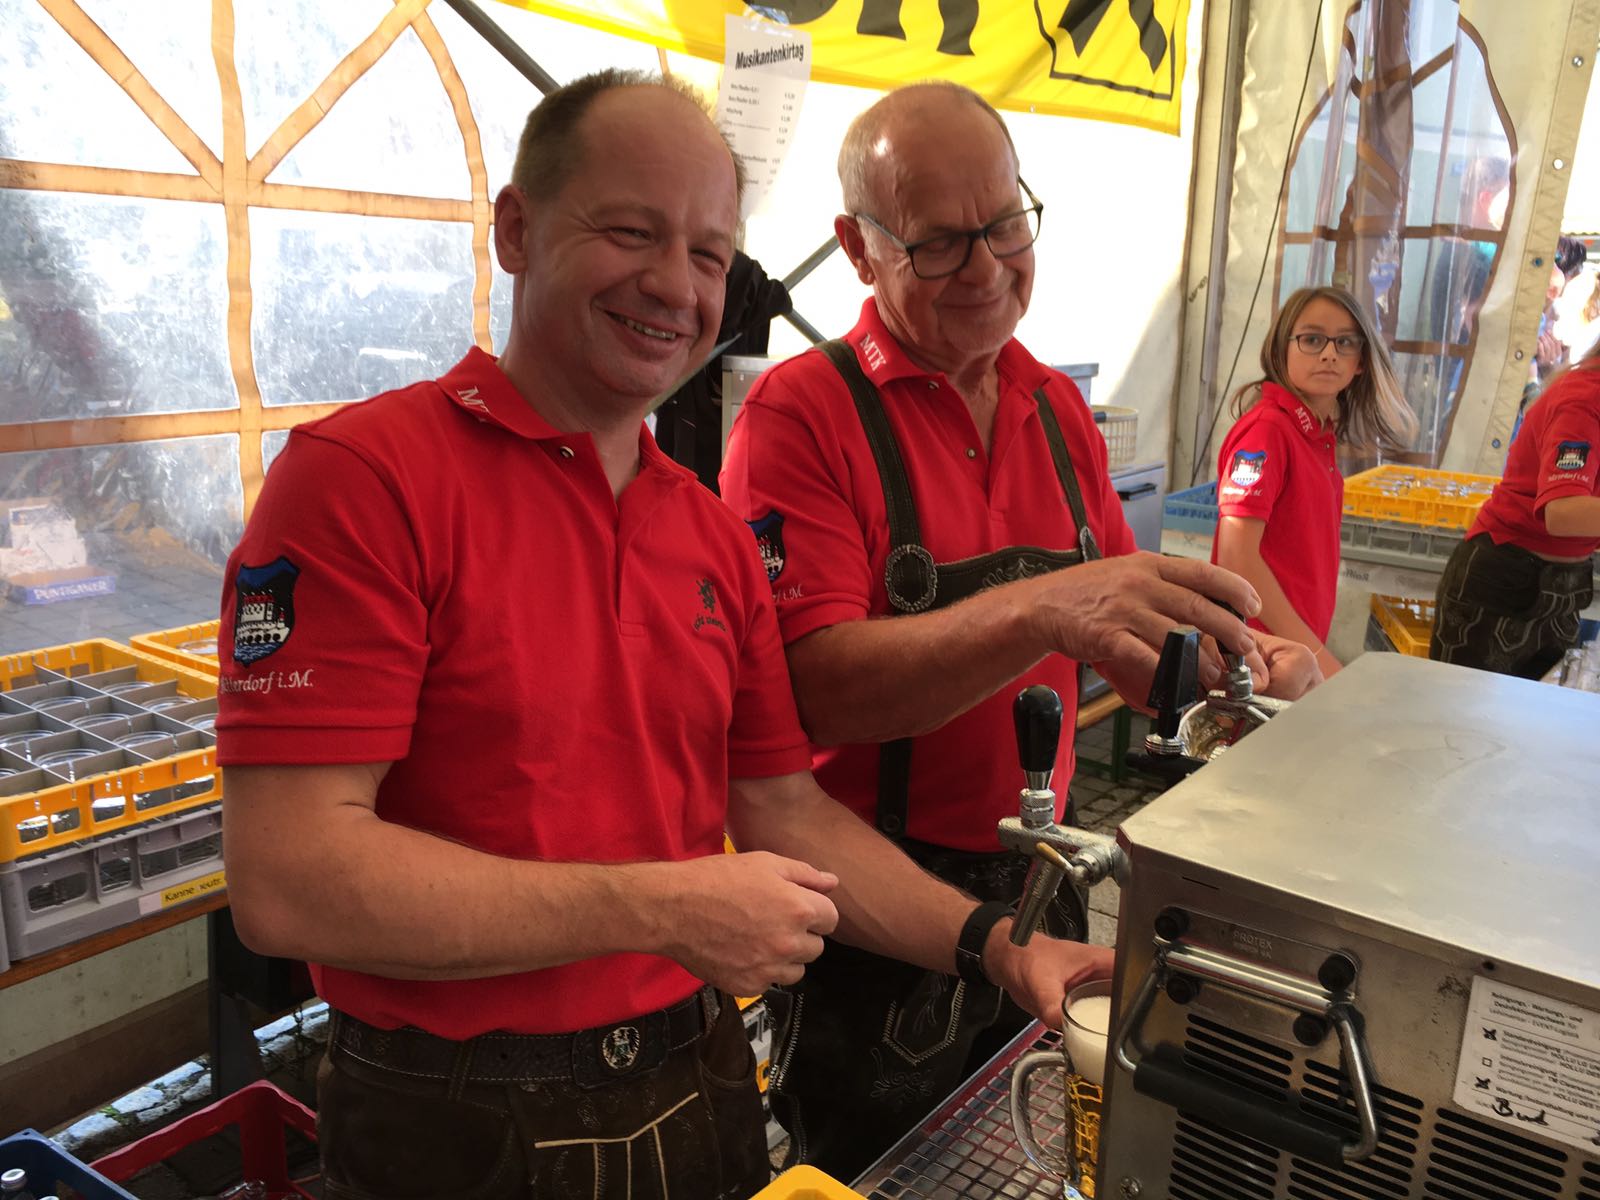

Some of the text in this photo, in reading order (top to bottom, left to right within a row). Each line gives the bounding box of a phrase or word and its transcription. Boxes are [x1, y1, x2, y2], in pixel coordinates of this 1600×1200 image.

[735, 42, 804, 70] Musikantenkirtag
[860, 332, 886, 371] MTK
[1295, 406, 1313, 432] MTK
[278, 668, 314, 688] i.M.
